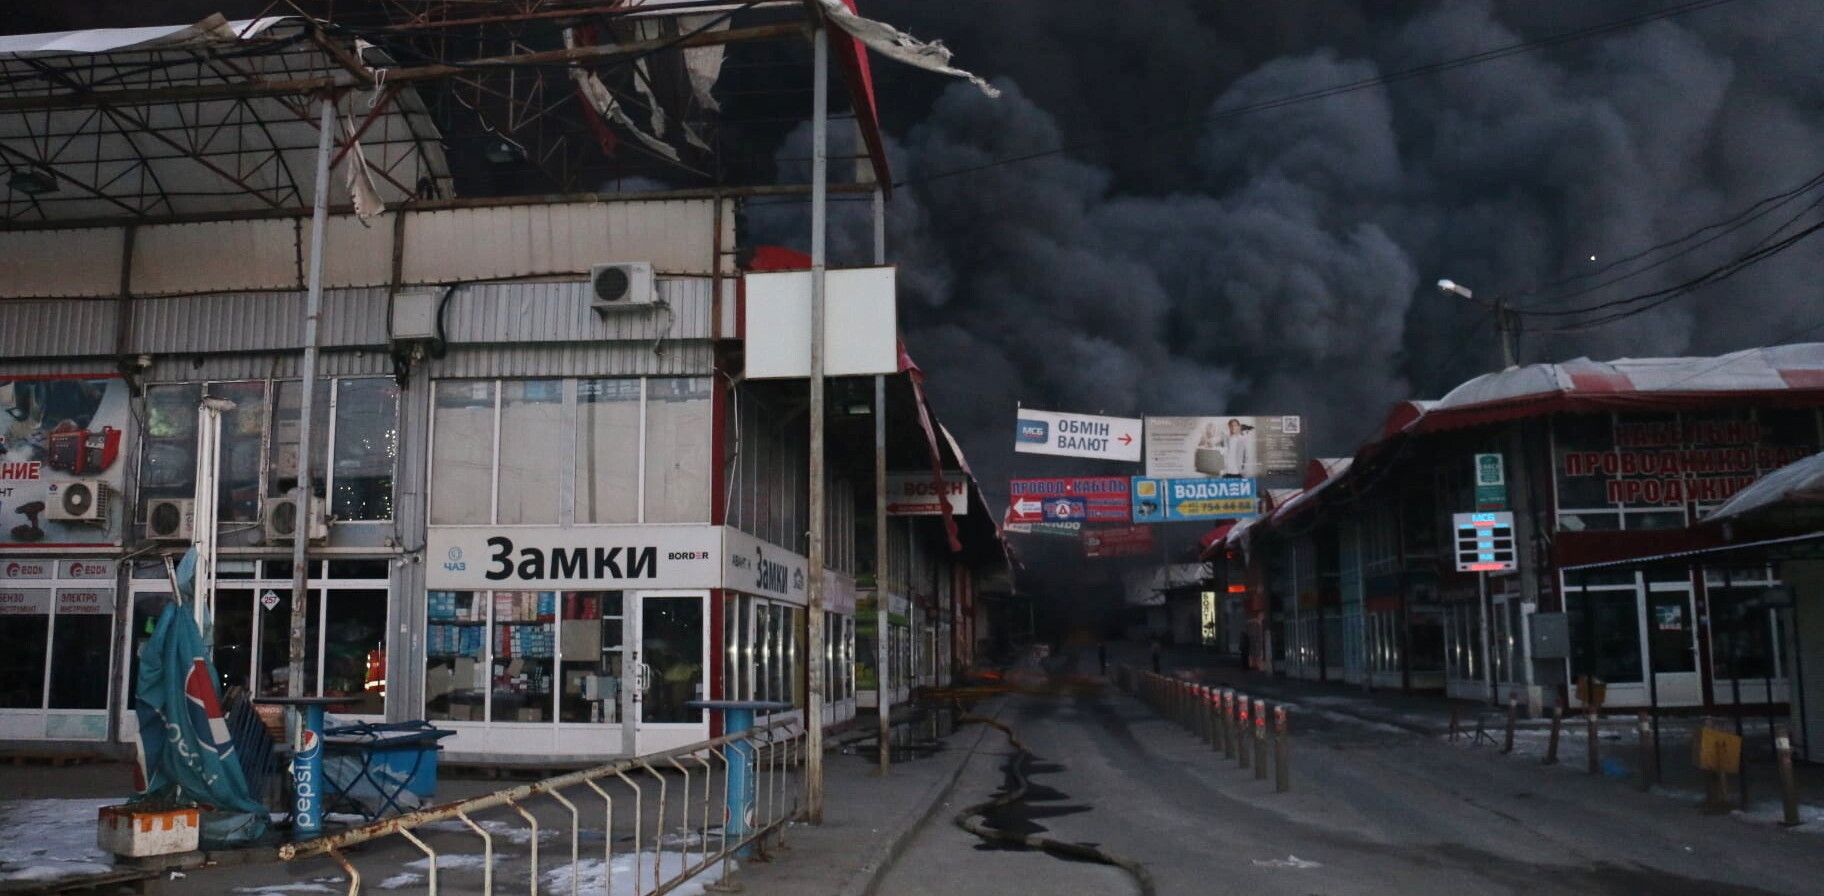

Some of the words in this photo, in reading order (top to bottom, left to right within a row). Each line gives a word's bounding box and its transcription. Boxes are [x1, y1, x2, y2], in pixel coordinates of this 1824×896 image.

[1059, 420, 1109, 436] ОБМІН
[1058, 436, 1108, 452] ВАЛЮТ
[0, 463, 41, 480] НИЕ
[1175, 479, 1251, 499] ВОДОЛЕЙ
[485, 536, 657, 581] Замки
[668, 552, 709, 561] BORDER
[443, 562, 466, 571] ЧАЗ
[756, 546, 788, 595] Замки
[61, 593, 97, 603] ЭЛЕКТРО
[0, 605, 37, 613] НСТРУМЕНТ
[296, 761, 317, 828] pepsi
